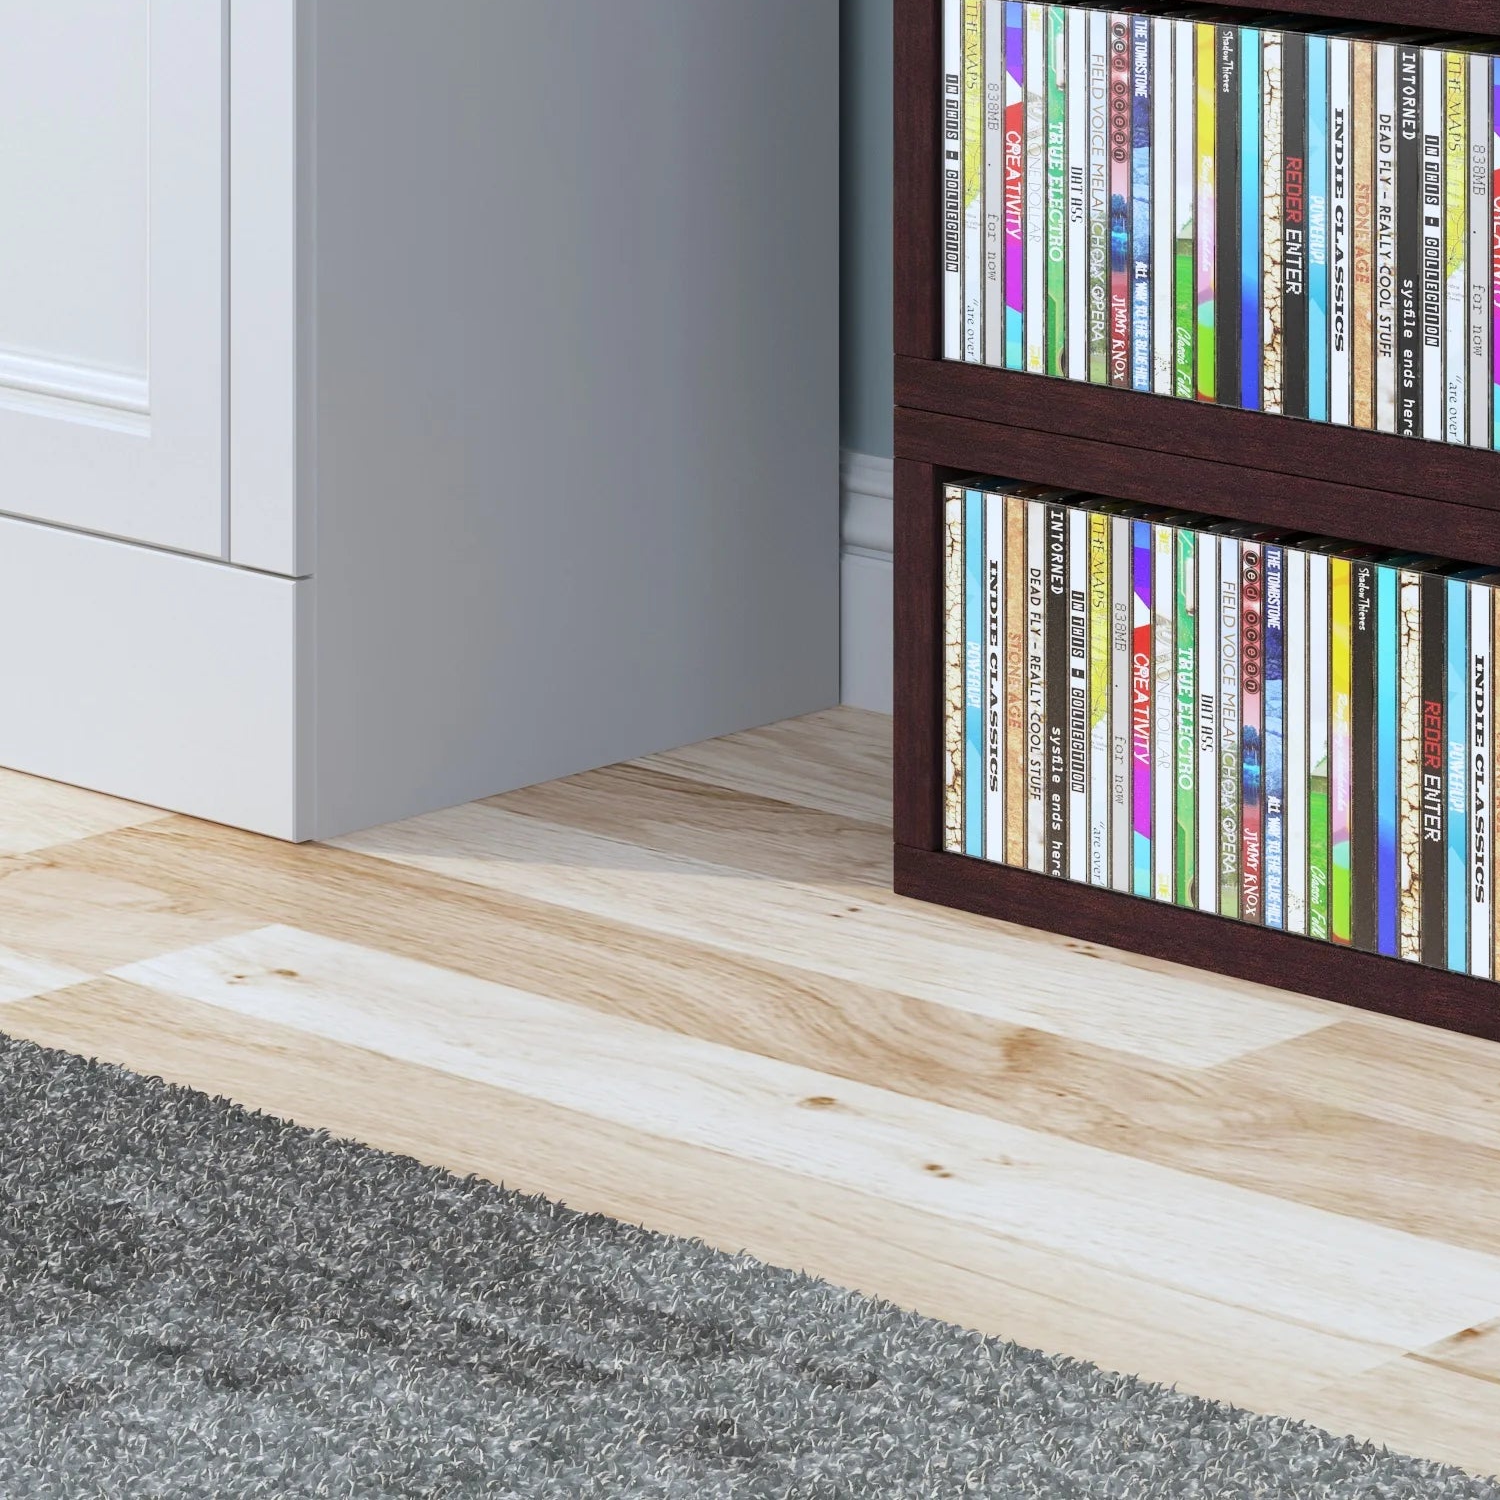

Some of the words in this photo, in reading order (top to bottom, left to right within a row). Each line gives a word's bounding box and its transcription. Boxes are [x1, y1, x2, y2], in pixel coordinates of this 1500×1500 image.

[946, 74, 958, 94] IN
[1091, 54, 1104, 100] FIELD
[1135, 41, 1147, 98] TOMBSTONE
[1402, 52, 1416, 140] INTORNED
[946, 100, 958, 140] THIS
[1091, 105, 1104, 156] VOICE
[1112, 80, 1127, 163] ocean
[1379, 114, 1391, 154] DEAD
[1335, 108, 1344, 199] INDIE
[1379, 159, 1391, 185] FLY
[1285, 157, 1302, 223] REDER
[946, 169, 958, 273] COLLECTION
[1379, 205, 1391, 260] REALLY
[1285, 229, 1302, 295] ENTER
[1335, 205, 1344, 351] CLASSICS
[1379, 266, 1391, 308] COOL
[1401, 279, 1415, 338] sysfile
[1472, 284, 1485, 314] for
[1379, 315, 1391, 357] STUFF
[1472, 325, 1485, 356] now
[1401, 349, 1415, 388] ends
[1050, 510, 1063, 595] INTORNED
[990, 560, 998, 646] INDIE
[1030, 568, 1041, 606] DEAD
[1072, 590, 1084, 613] IN
[1267, 571, 1280, 630] TOMBSTONE
[1030, 611, 1041, 636] FLY
[1072, 616, 1084, 658] THIS
[1030, 655, 1041, 707] REALLY
[1178, 647, 1193, 695] TRUE
[990, 652, 998, 792] CLASSICS
[1475, 655, 1484, 747] INDIE
[1030, 713, 1041, 755] COOL
[1050, 727, 1063, 784] sysfile
[1072, 688, 1084, 792] COLLECTION
[1178, 701, 1193, 790] ELECTRO
[1424, 700, 1441, 768] REDER
[1030, 761, 1041, 801] STUFF
[1424, 774, 1441, 842] ENTER
[1050, 793, 1063, 830] ends
[1475, 754, 1484, 903] CLASSICS
